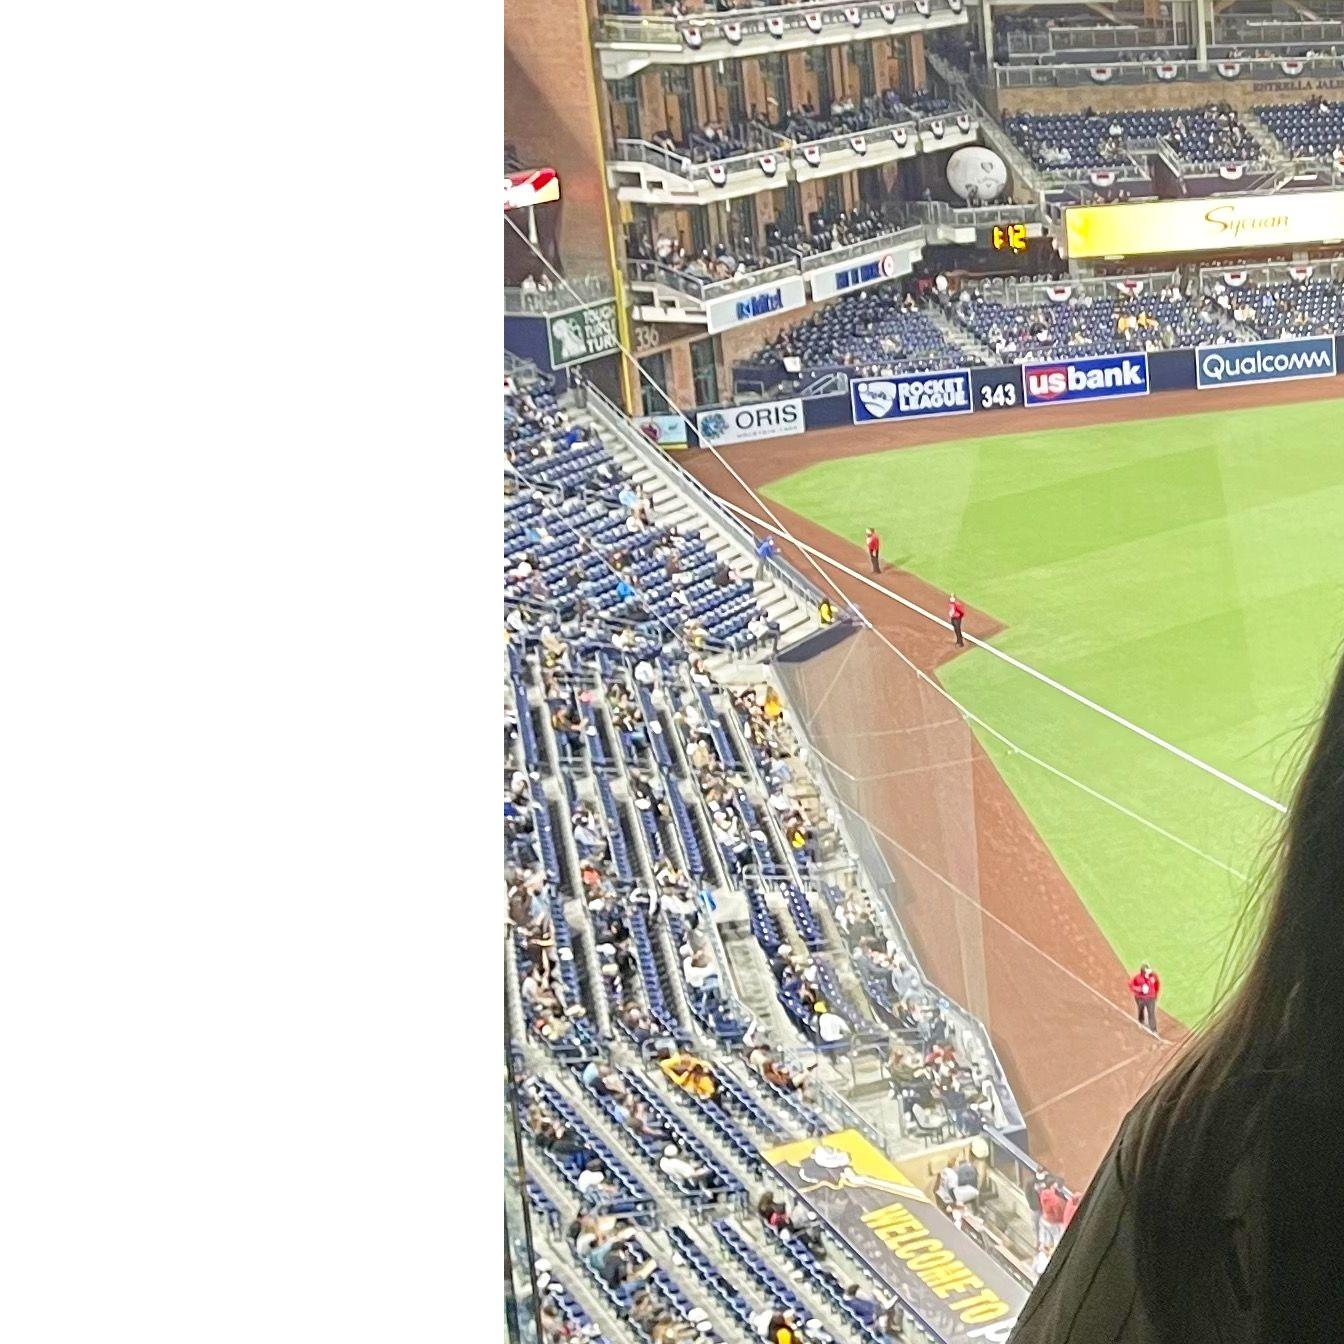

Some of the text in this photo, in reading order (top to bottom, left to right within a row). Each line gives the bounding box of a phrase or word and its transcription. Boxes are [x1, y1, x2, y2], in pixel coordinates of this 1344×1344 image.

[1204, 206, 1289, 238] Sycuan
[1202, 350, 1330, 380] Qualcomm
[899, 377, 965, 396] ROCKET
[981, 383, 1016, 408] 343
[900, 391, 968, 412] LEAGUE
[735, 404, 797, 430] ORIS
[861, 1203, 1009, 1324] WELCOME TO
